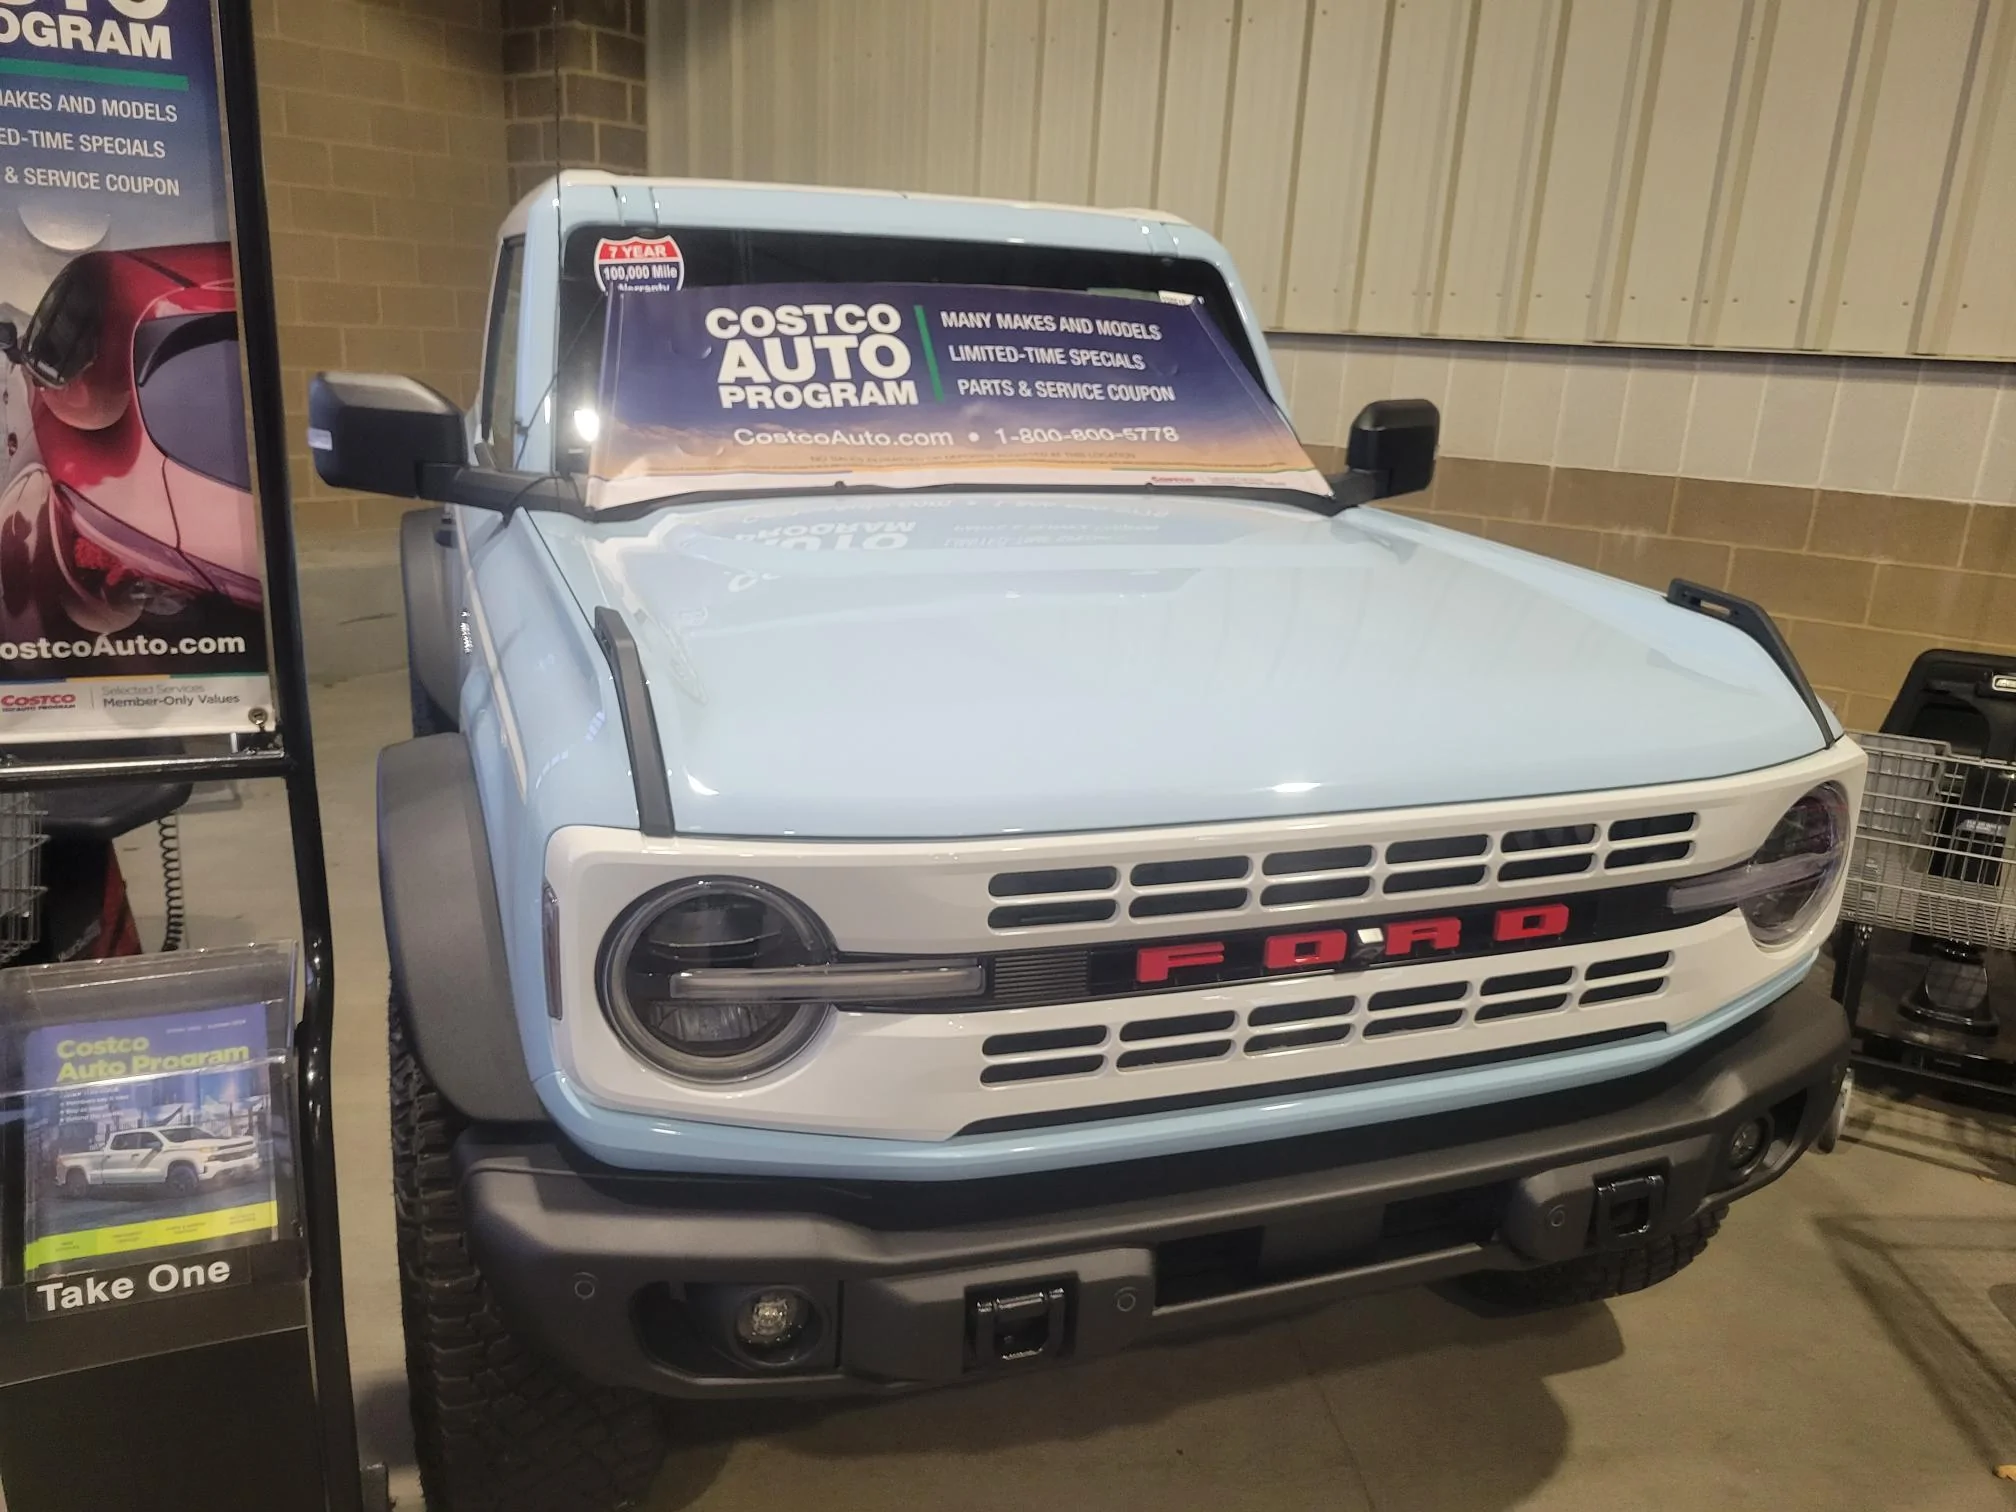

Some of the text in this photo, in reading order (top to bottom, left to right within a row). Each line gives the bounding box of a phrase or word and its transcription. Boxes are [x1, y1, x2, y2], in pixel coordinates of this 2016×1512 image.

[0, 89, 178, 123] AKES AND MODELS
[79, 134, 166, 158] SPECIALS
[4, 166, 180, 196] & SERVICE COUPON
[608, 244, 667, 259] 7 YEAR
[603, 264, 678, 282] 100,000 Mile
[705, 303, 901, 339] COSTCO
[940, 311, 1163, 341] MANY MAKES AND MODELS
[717, 333, 911, 384] AUTO
[948, 345, 1146, 371] LIMITED-TIME SPECIALS
[718, 381, 919, 410] PROGRAM
[957, 379, 1177, 402] PARTS & SERVICE COUPON
[733, 426, 1180, 447] CostcoAuto.com 1-800-800-5778
[103, 694, 241, 708] Member-Only Values
[1136, 904, 1570, 983] FORD
[57, 1036, 149, 1059] Costco
[56, 1045, 249, 1083] Auto Program
[37, 1260, 231, 1312] Take One
